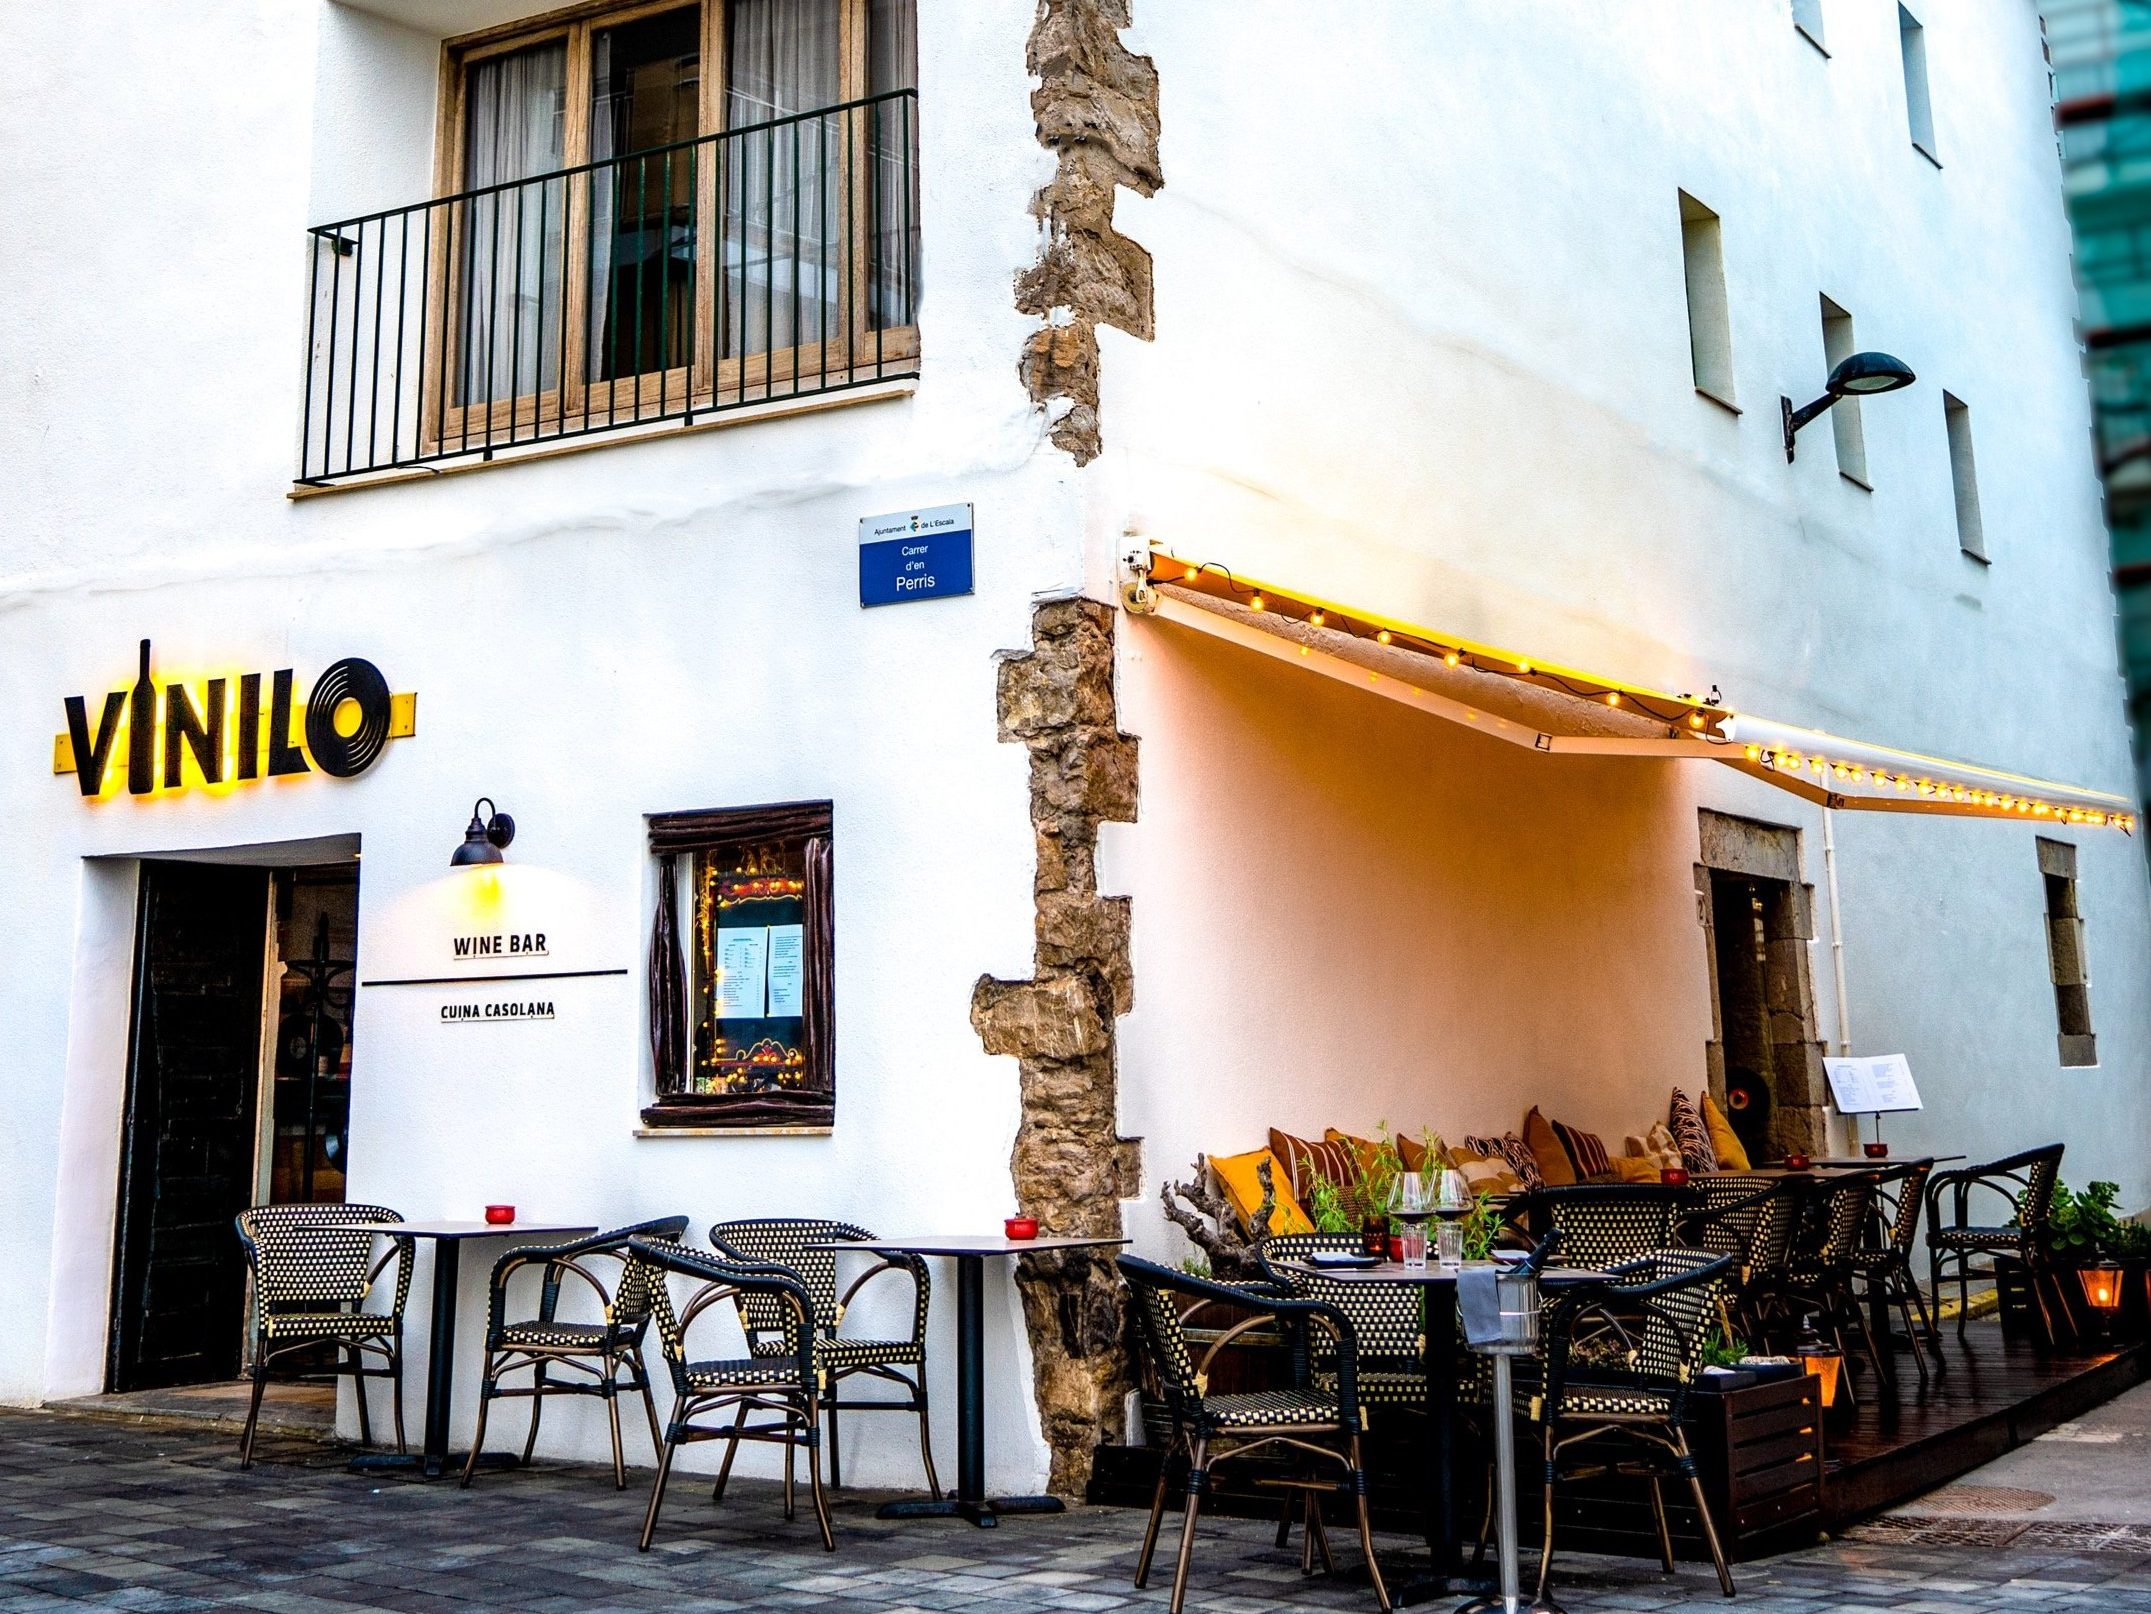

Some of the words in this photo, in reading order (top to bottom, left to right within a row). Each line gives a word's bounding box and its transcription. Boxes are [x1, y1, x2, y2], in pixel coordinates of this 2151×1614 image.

[874, 525, 906, 536] Ajuntament
[921, 521, 929, 529] de
[930, 518, 954, 528] L'Escala
[901, 545, 929, 556] Carrer
[905, 561, 925, 571] d'en
[896, 574, 936, 591] Perris
[64, 639, 392, 796] VINILO
[453, 935, 502, 956] WINE
[510, 933, 546, 952] BAR
[440, 1004, 480, 1018] CUINA
[485, 1002, 555, 1016] CASOLANA
